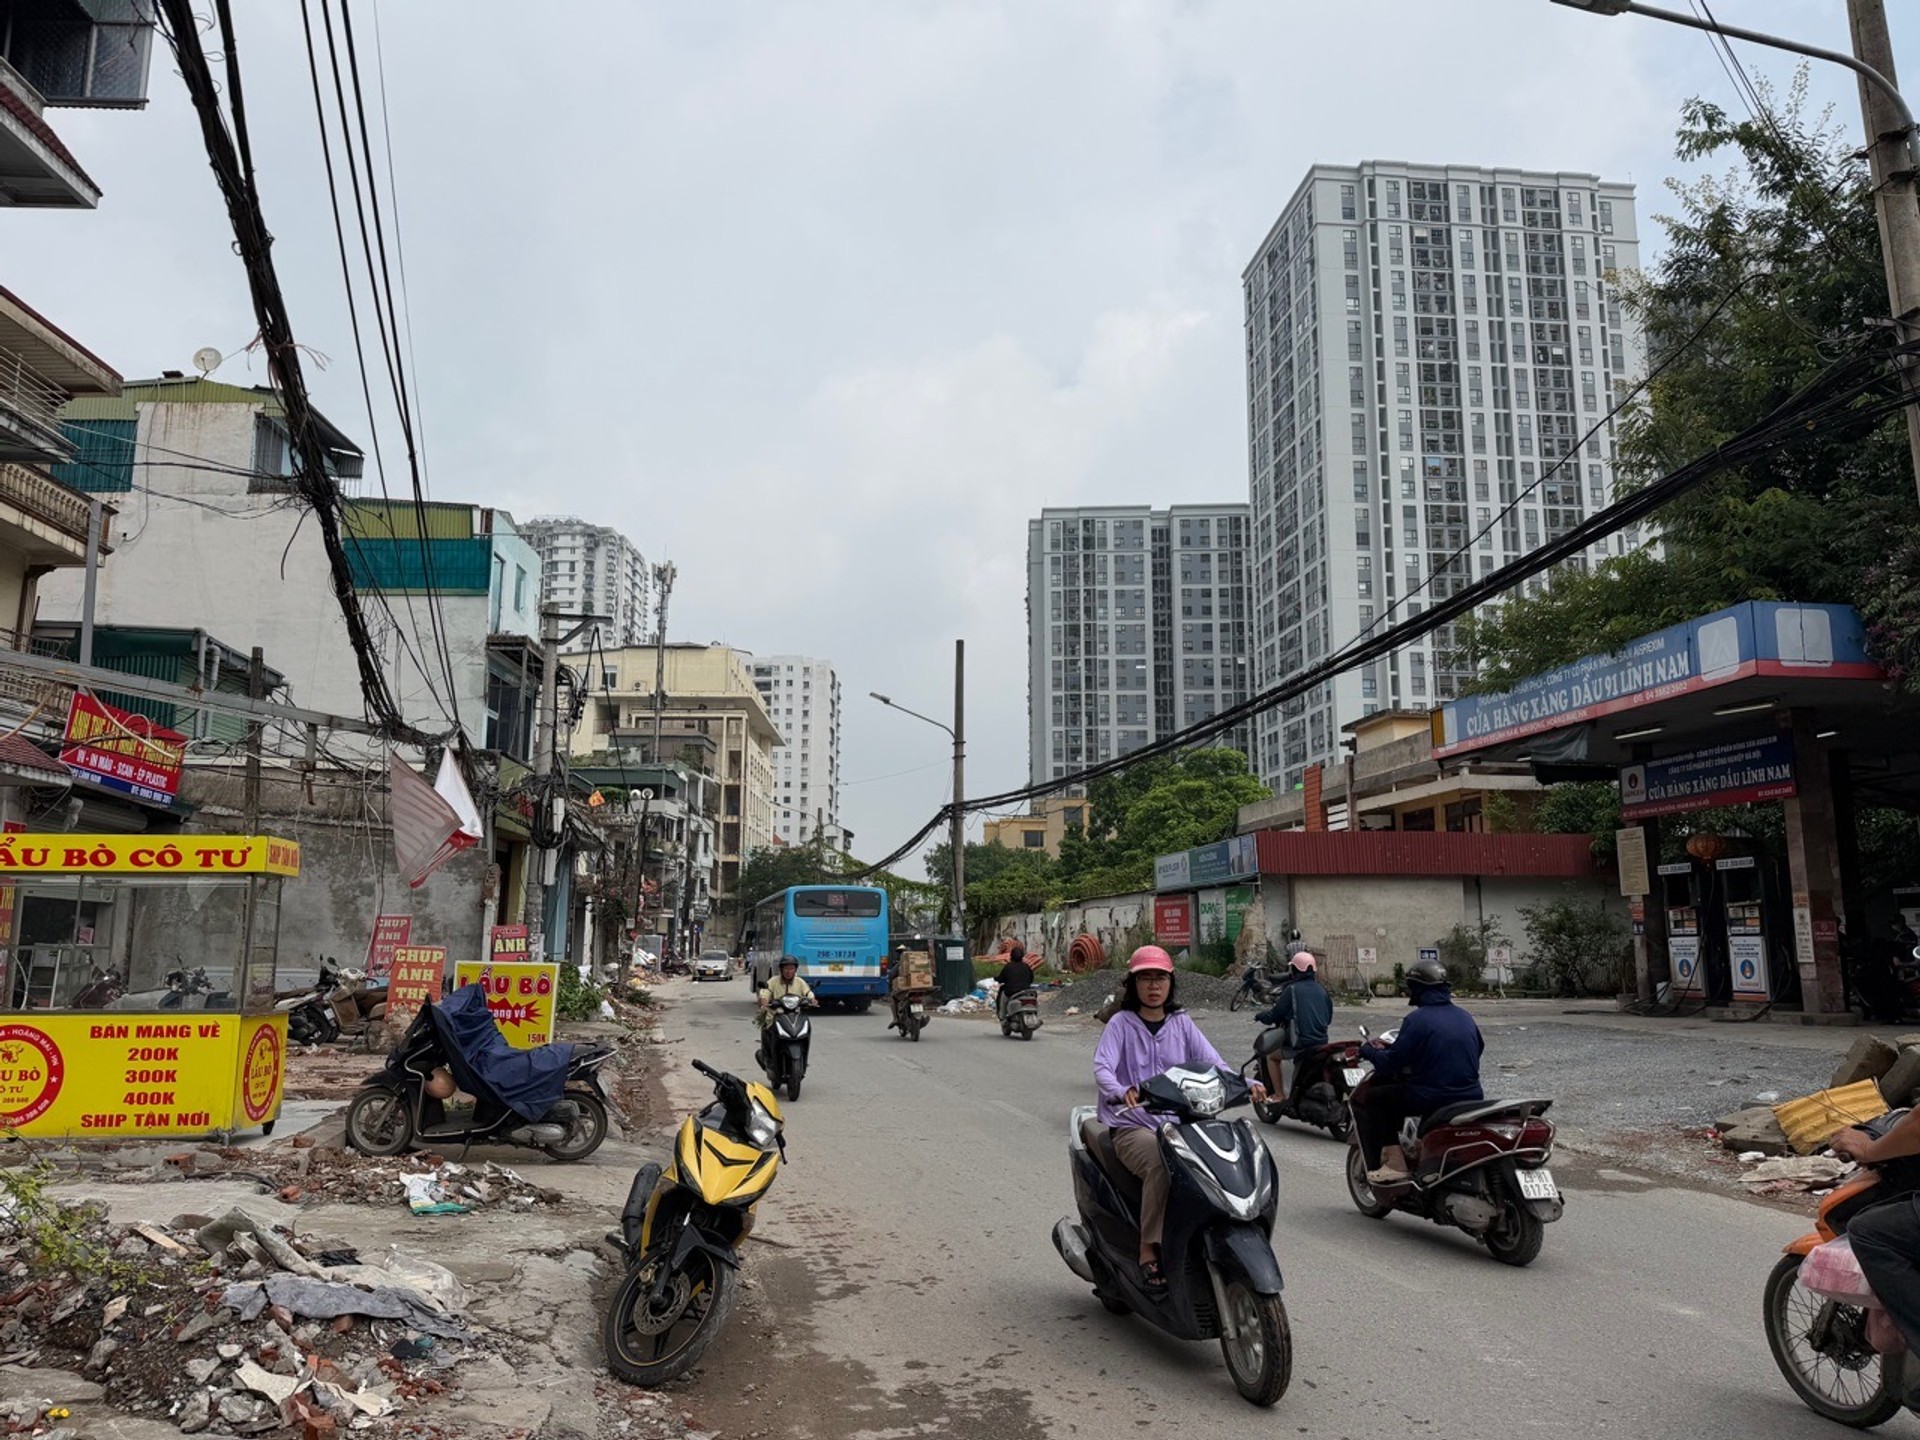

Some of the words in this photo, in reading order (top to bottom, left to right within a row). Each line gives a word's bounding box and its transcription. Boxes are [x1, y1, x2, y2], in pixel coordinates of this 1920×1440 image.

[1467, 707, 1490, 736] CỬA
[1493, 702, 1528, 729] HÀNG
[1530, 689, 1568, 719] XĂNG
[1571, 673, 1603, 708] DẦU
[1604, 673, 1618, 697] 91
[1620, 662, 1654, 694] LĨNH
[1656, 651, 1690, 684] NAM
[1648, 780, 1666, 801] CỬA
[1667, 778, 1691, 798] HÀNG
[1691, 775, 1719, 795] XĂNG
[1743, 766, 1765, 785] LĨNH
[1766, 763, 1791, 782] NAM
[62, 844, 116, 868] BÒ
[129, 844, 182, 868] CÔ
[195, 846, 252, 868] TƯ
[494, 933, 527, 953] ẢNH
[395, 948, 444, 967] CHỤP
[397, 963, 435, 982] ẢNH
[488, 1008, 512, 1019] ang
[135, 1025, 191, 1039] MANG
[198, 1020, 221, 1038] VỀ
[127, 1047, 180, 1062] 200K
[18, 1066, 41, 1082] BÒ
[124, 1069, 178, 1084] 300K
[9, 1084, 24, 1093] TƯ
[122, 1092, 176, 1106] 400K
[80, 1113, 128, 1128] SHIP
[134, 1111, 170, 1130] TẬN
[176, 1111, 211, 1127] NƠI
